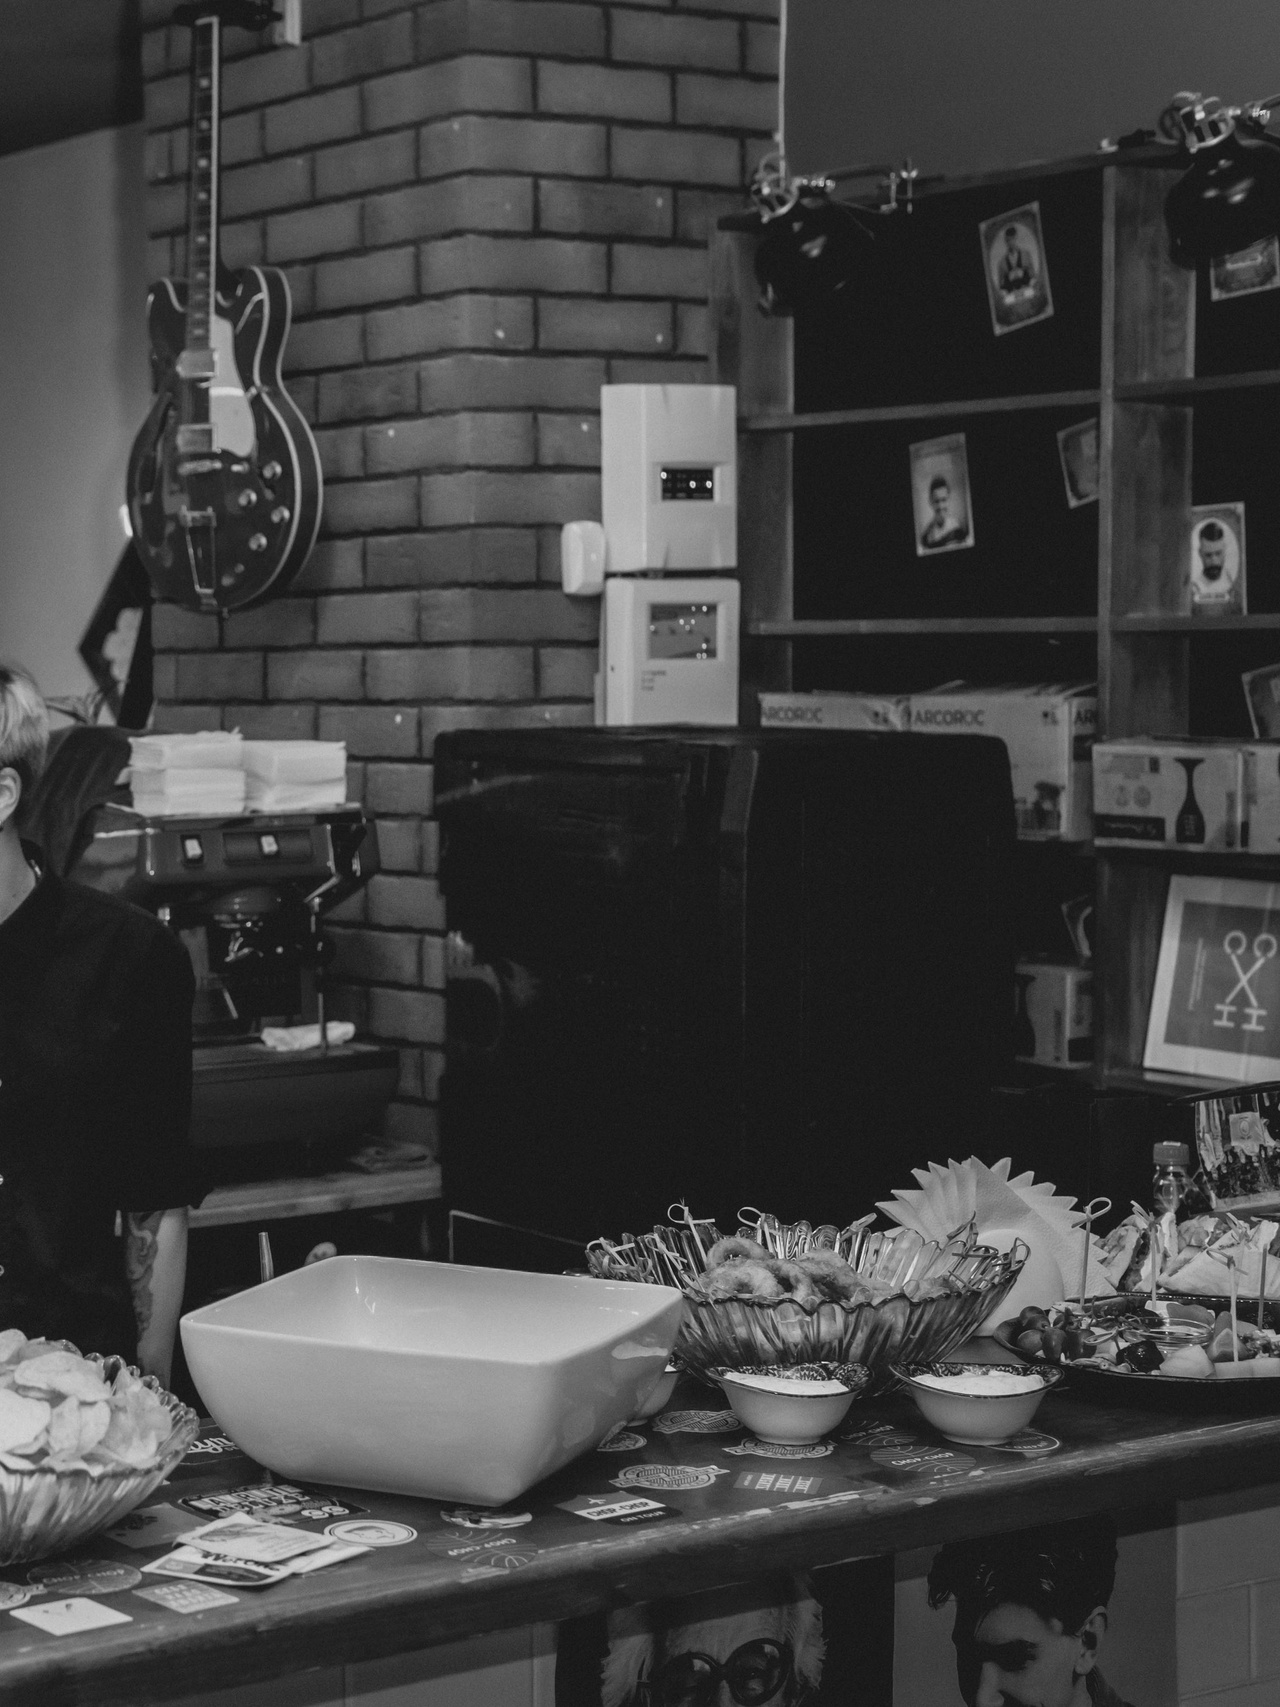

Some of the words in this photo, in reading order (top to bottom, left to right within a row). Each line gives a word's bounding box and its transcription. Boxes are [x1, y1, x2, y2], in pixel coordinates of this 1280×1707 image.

[914, 709, 985, 727] ARCOROC
[891, 1452, 954, 1466] CHOP-CHOP
[587, 1501, 650, 1517] CHOP-CHOP
[620, 1515, 638, 1523] ON
[639, 1511, 666, 1520] TOUR
[448, 1538, 517, 1556] CHOP-CHOP
